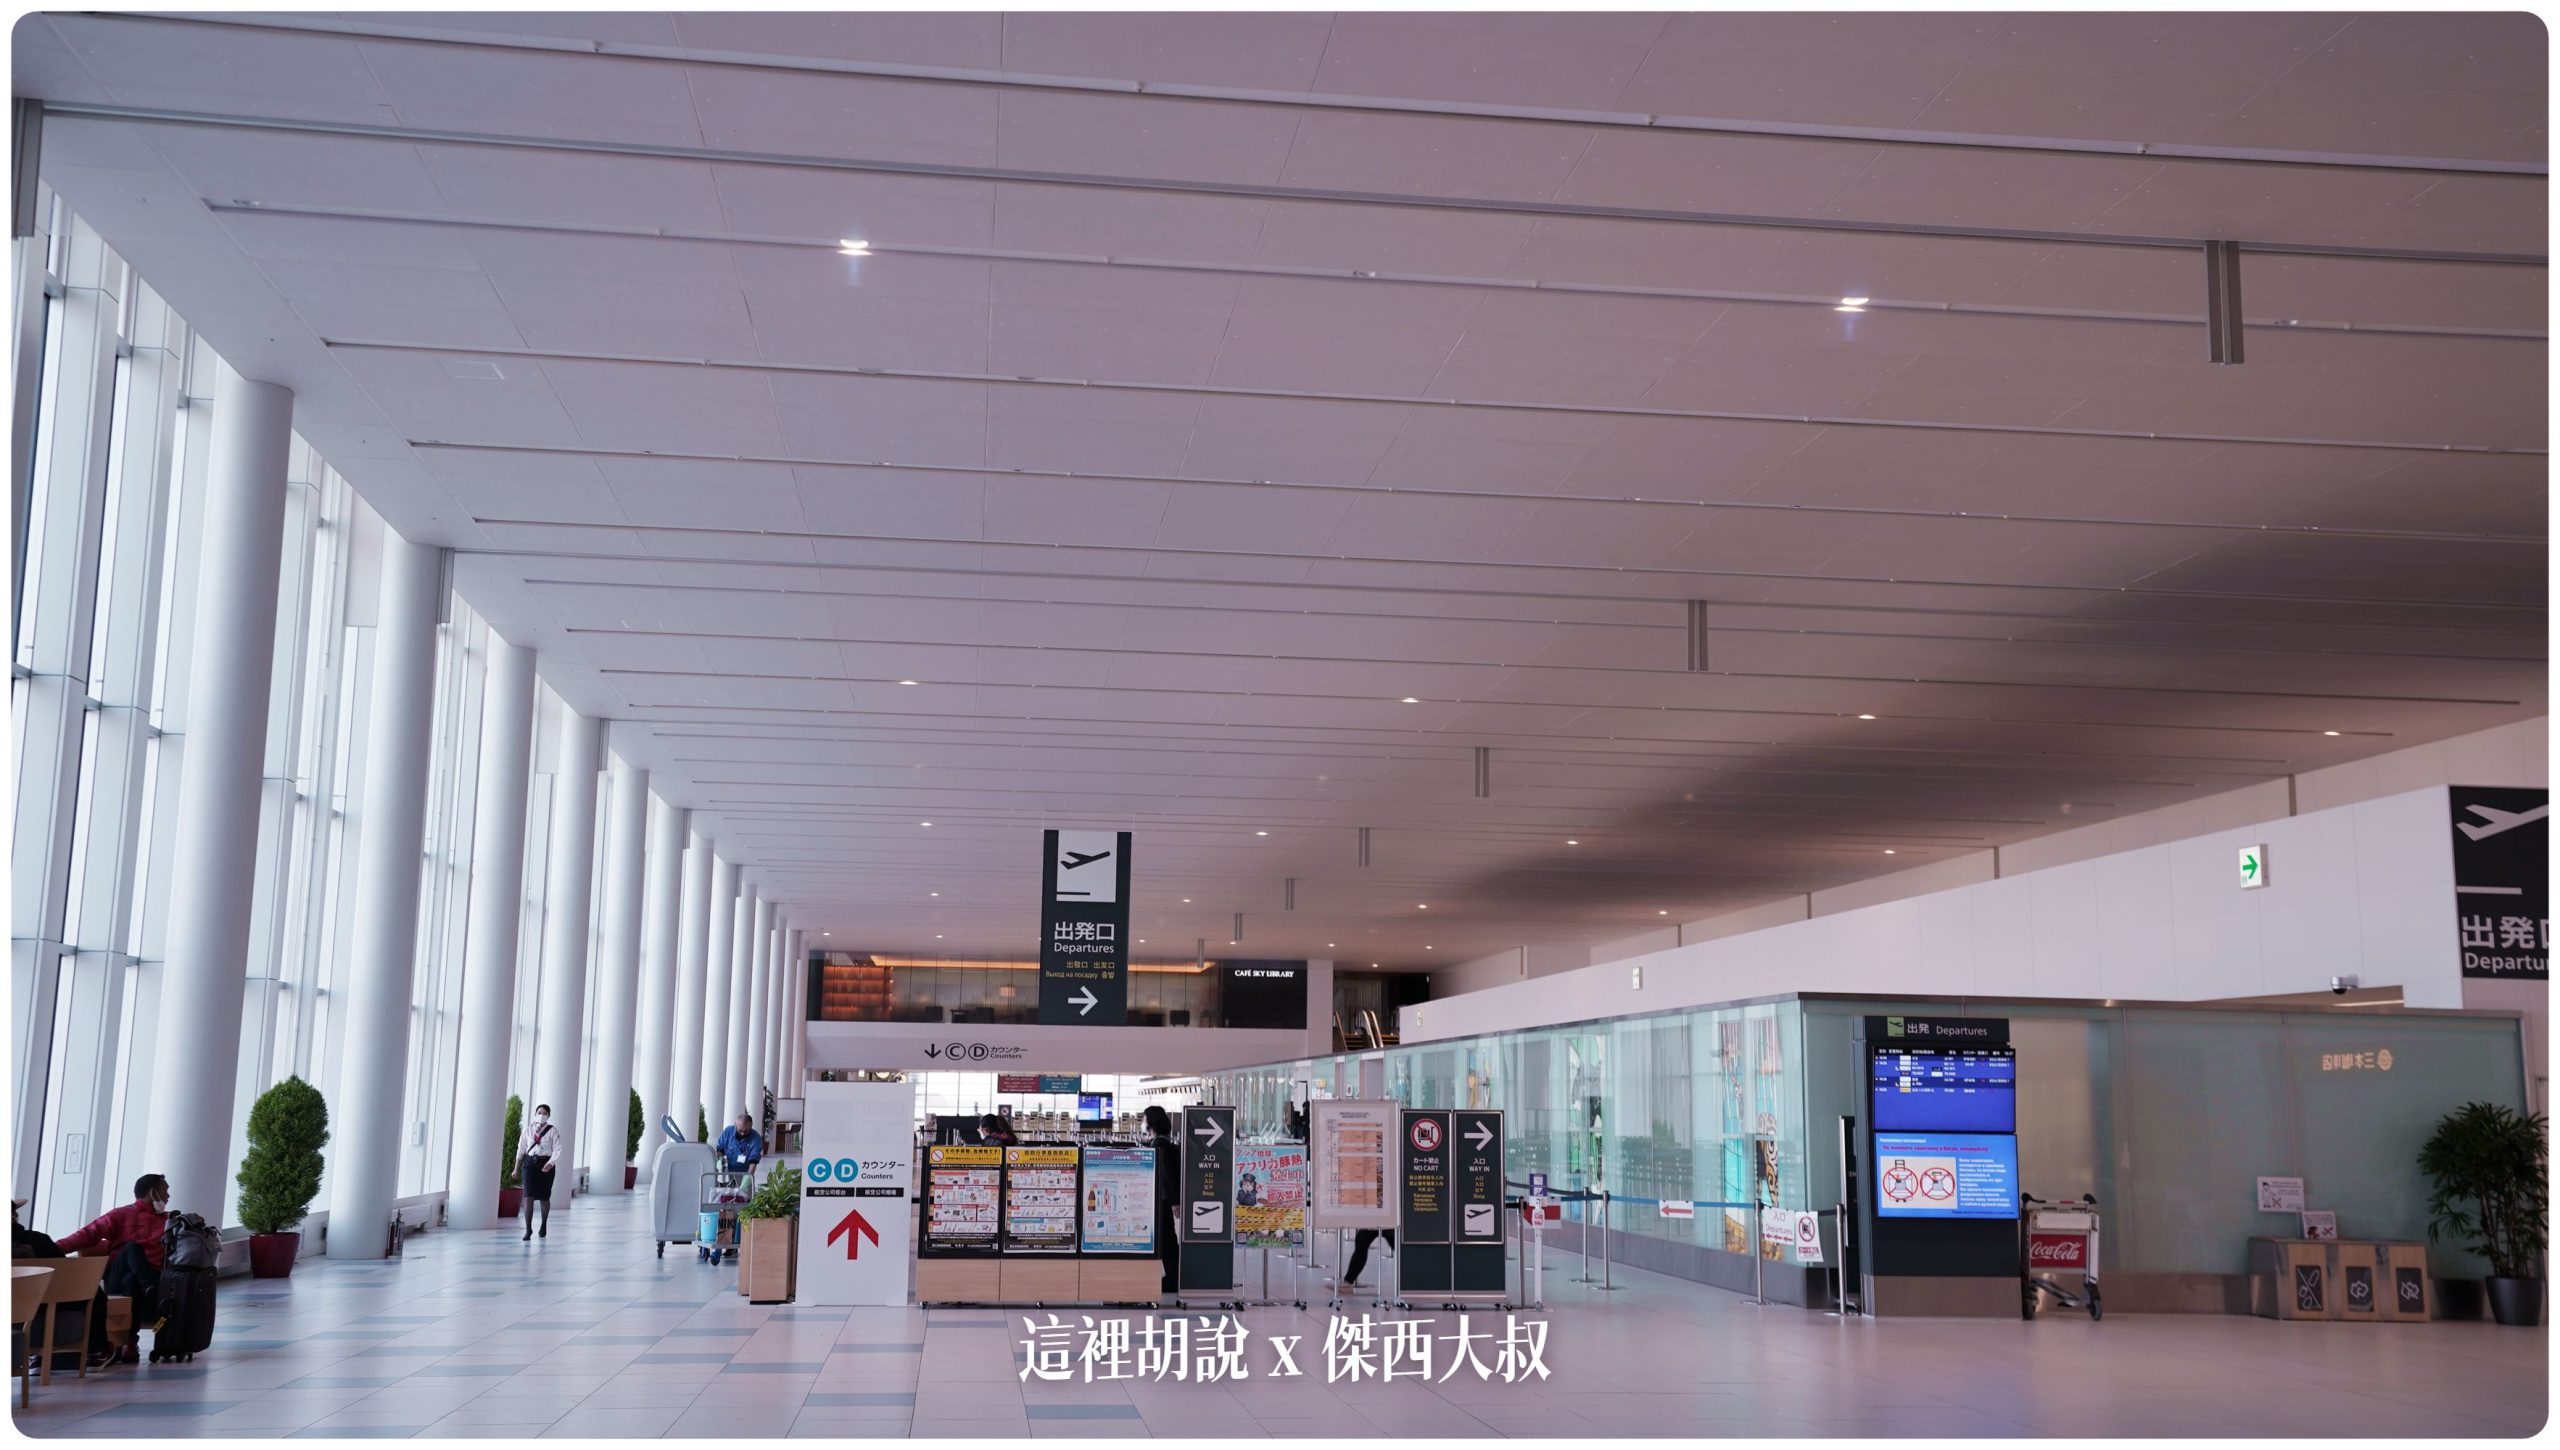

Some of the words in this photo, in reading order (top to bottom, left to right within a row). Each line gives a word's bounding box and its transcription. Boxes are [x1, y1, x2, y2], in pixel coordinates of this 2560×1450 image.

[1054, 921, 1115, 941] 出発口
[1054, 942, 1114, 955] Departures
[1234, 969, 1252, 977] CAFÉ
[1266, 970, 1294, 978] LIBRARY
[1907, 1022, 1930, 1035] 出発
[1936, 1025, 1988, 1036] Departures
[861, 1160, 905, 1170] カウンター
[1235, 1153, 1303, 1175] アフリカ豚熱
[861, 1172, 894, 1180] Counters
[1772, 1212, 1786, 1221] 入口
[1765, 1224, 1792, 1235] Departures
